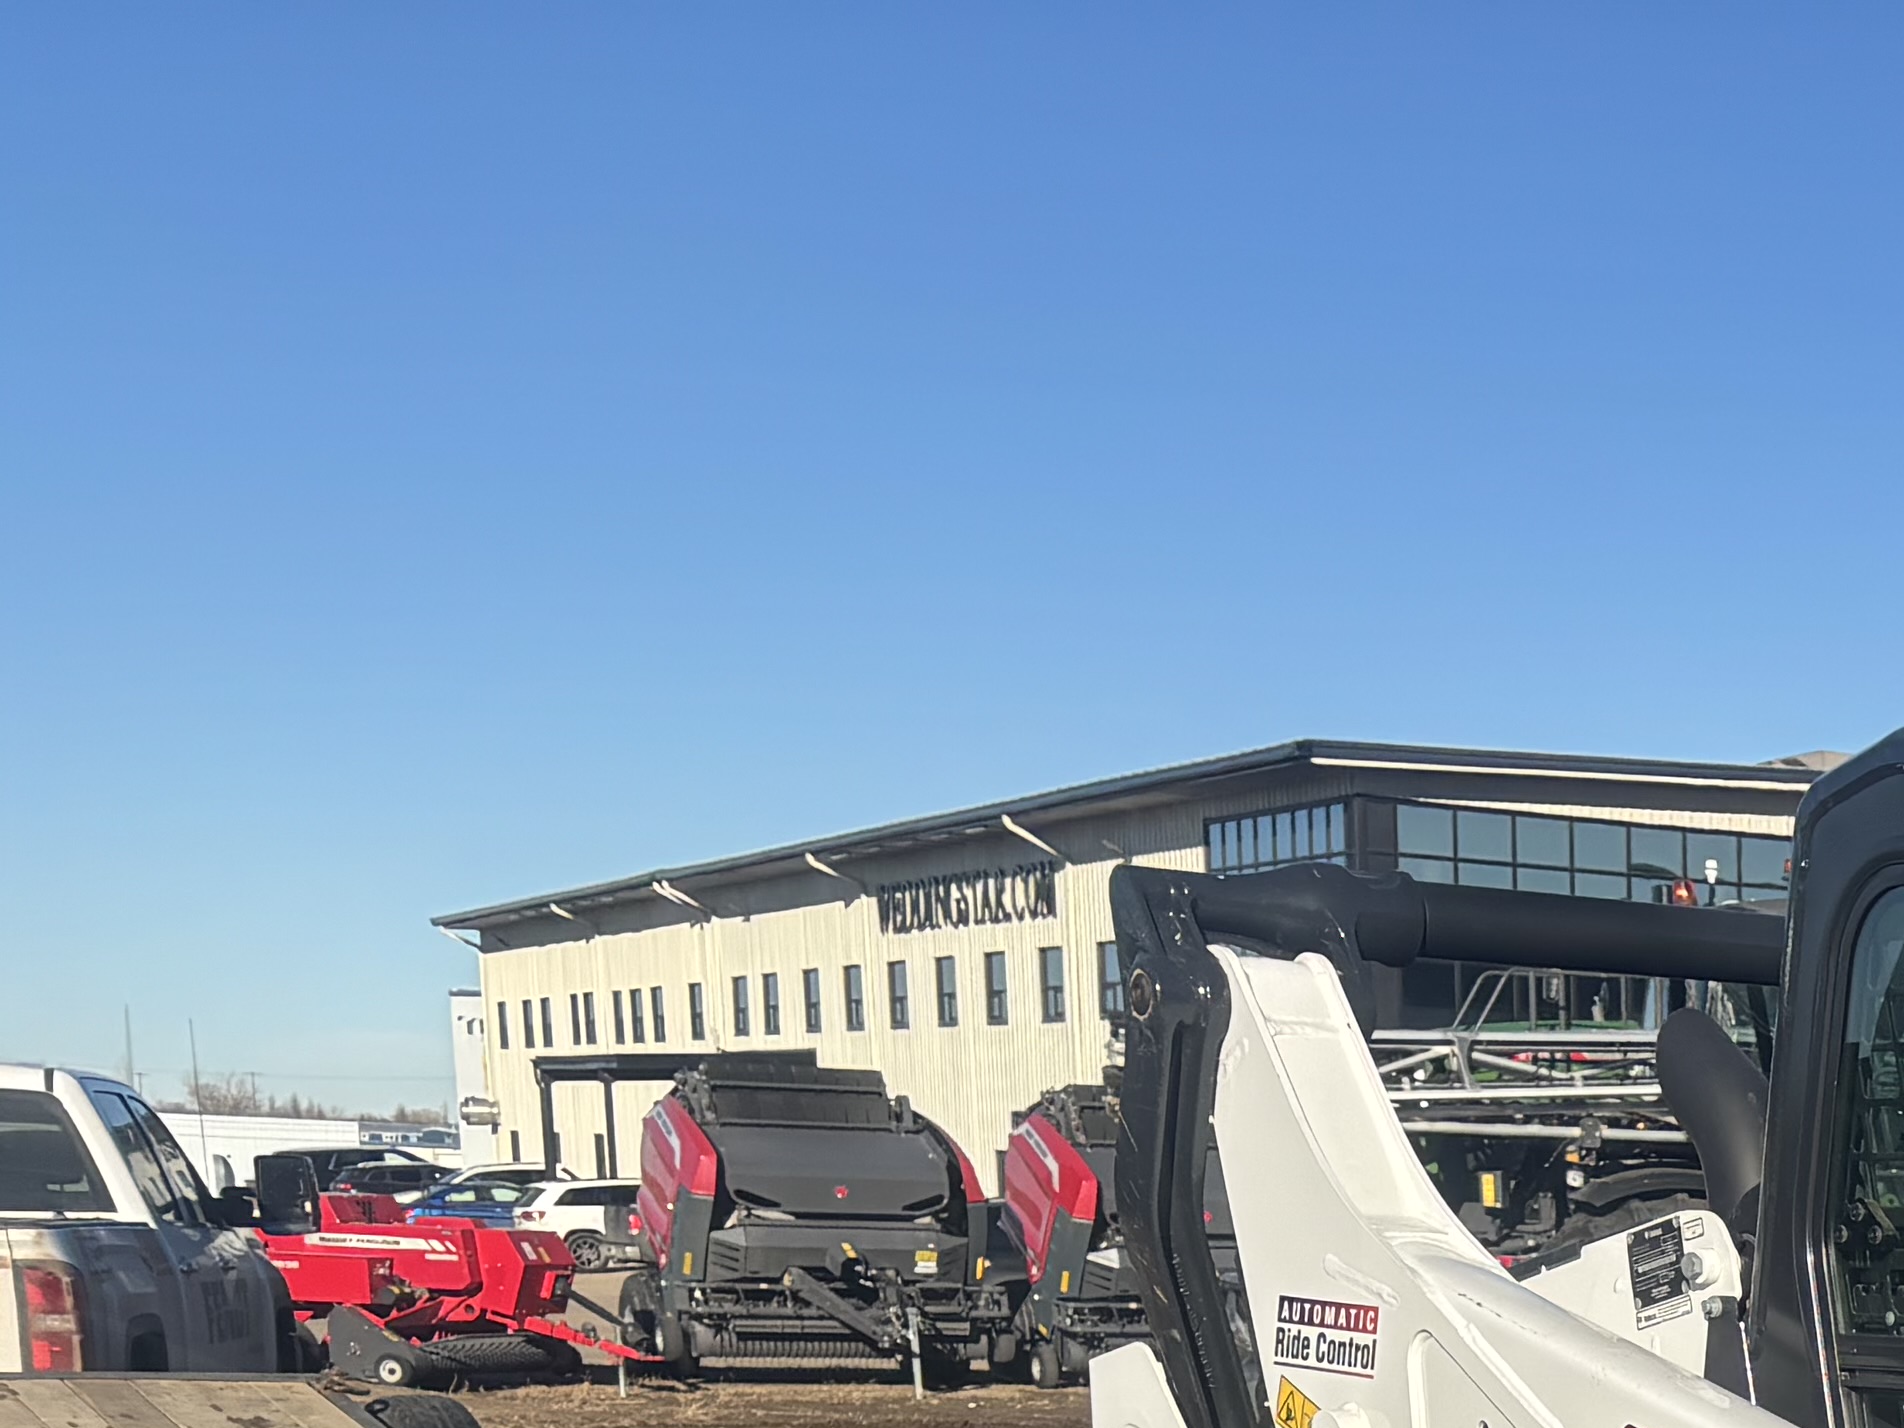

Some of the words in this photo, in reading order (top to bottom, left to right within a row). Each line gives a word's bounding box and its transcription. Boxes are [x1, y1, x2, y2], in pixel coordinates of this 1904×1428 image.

[1280, 1299, 1376, 1332] AUTOMATIC
[1274, 1326, 1311, 1362] Ride
[1315, 1331, 1377, 1371] Control
